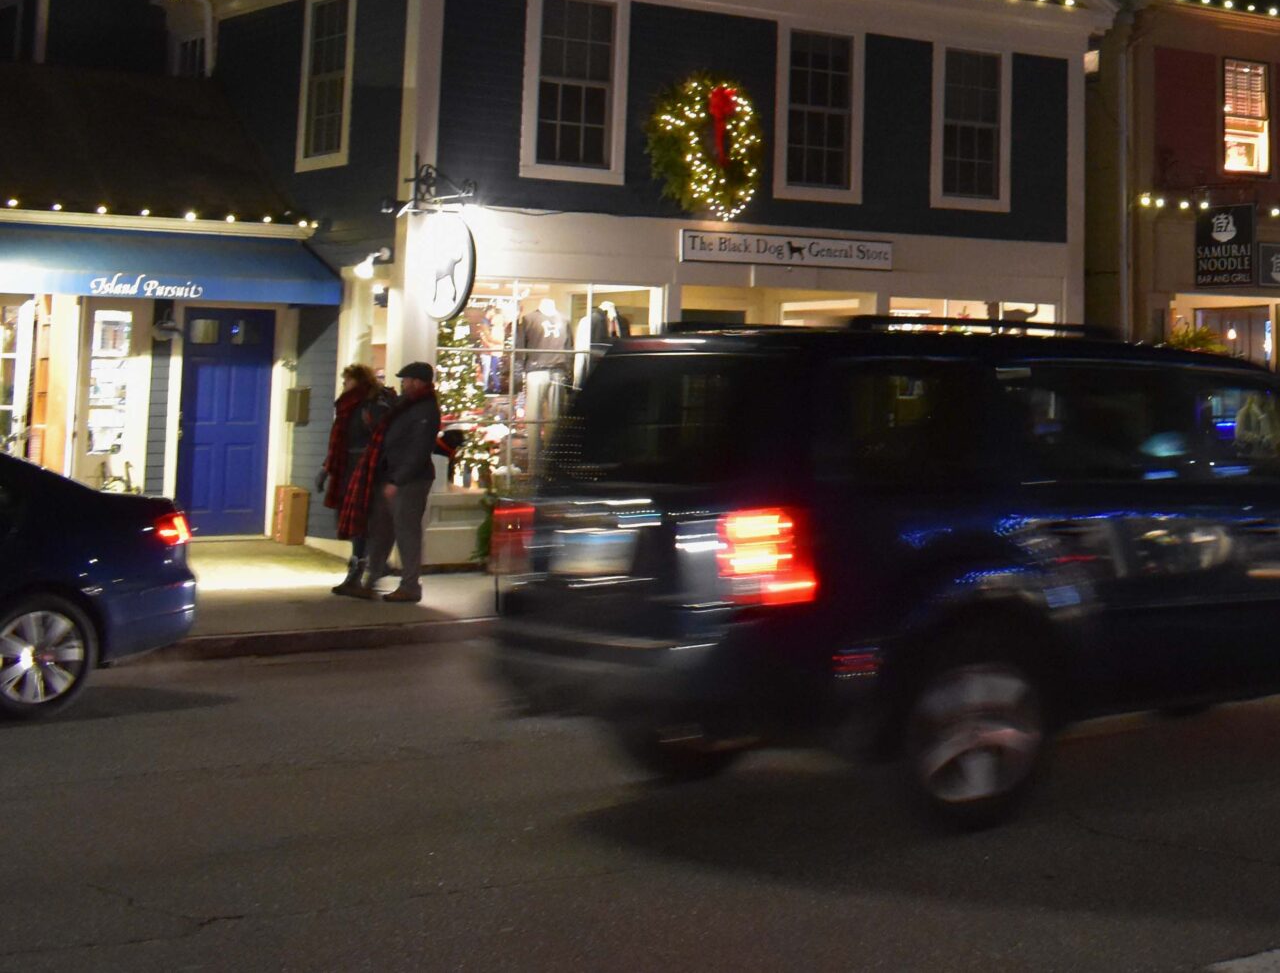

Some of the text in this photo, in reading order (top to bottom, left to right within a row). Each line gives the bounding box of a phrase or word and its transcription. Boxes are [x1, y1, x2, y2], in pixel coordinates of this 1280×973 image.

[688, 235, 890, 262] The Black Dog General Store
[1196, 243, 1252, 259] SAMURAI
[1198, 256, 1252, 273] NOODLE
[90, 272, 204, 299] Island Pursuit
